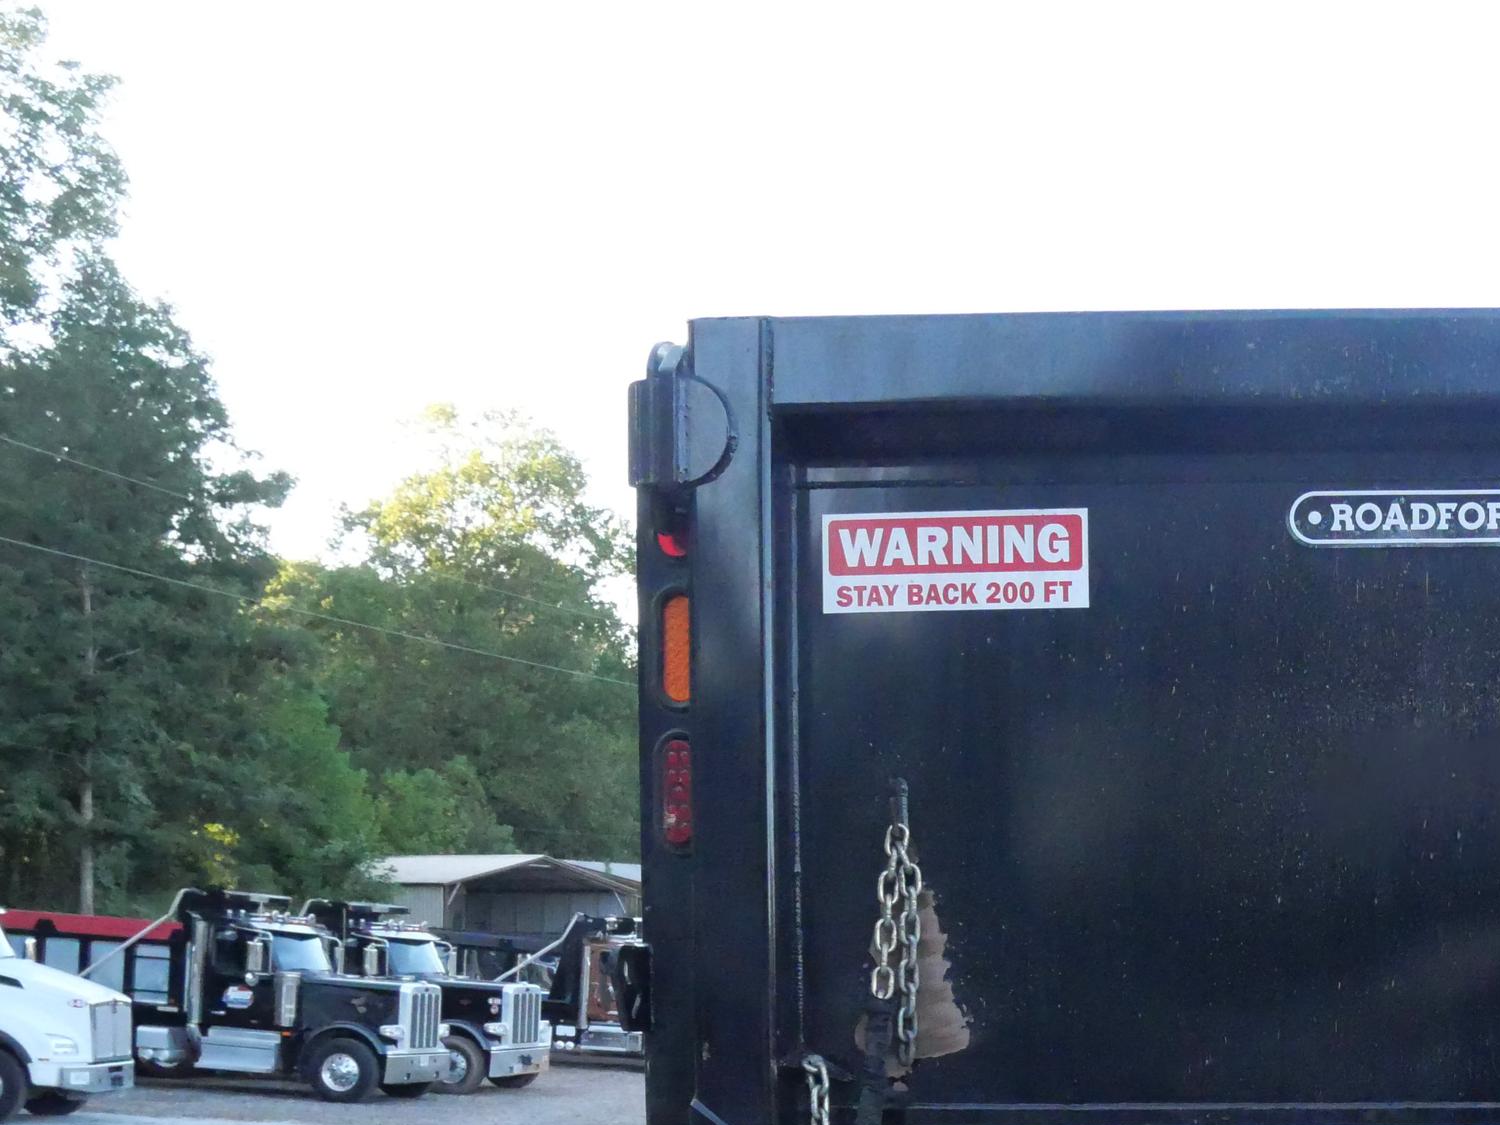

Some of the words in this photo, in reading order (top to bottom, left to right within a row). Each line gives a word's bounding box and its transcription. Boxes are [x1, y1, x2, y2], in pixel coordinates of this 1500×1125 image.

[838, 523, 1070, 567] WARNING
[836, 584, 899, 608] STAY
[907, 582, 978, 606] BACK
[985, 581, 1035, 604] 200
[1043, 580, 1073, 603] FT
